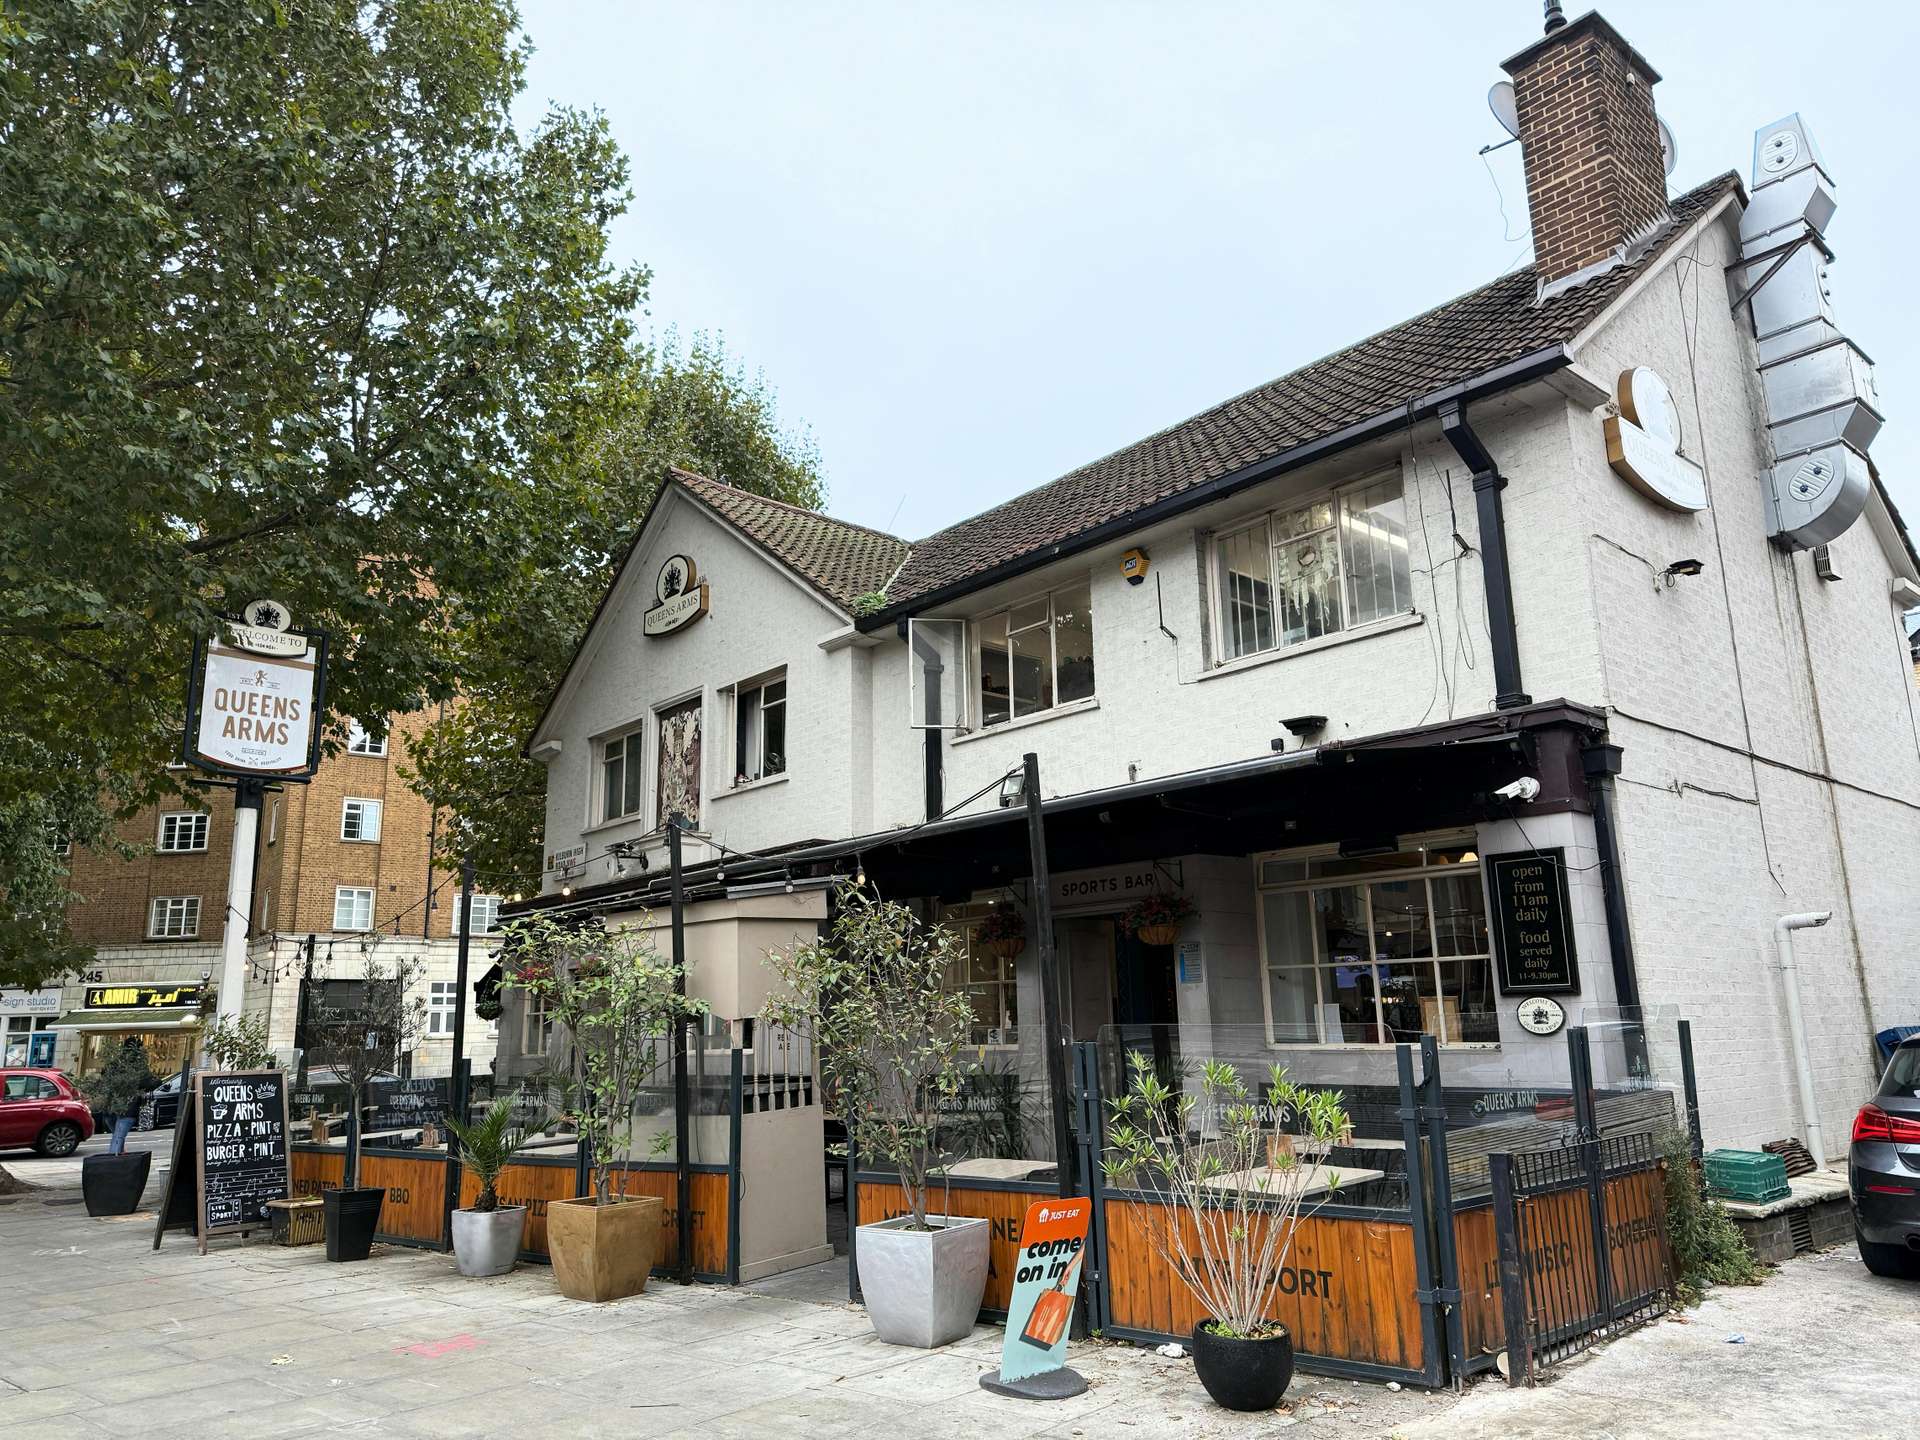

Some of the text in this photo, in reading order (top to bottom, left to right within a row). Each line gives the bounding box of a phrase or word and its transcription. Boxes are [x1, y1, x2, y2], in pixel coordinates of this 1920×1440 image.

[647, 605, 676, 627] QUEENS
[676, 595, 698, 613] ARMS
[288, 637, 303, 648] TO
[214, 687, 301, 722] QUEENS
[222, 715, 289, 746] ARMS
[1512, 866, 1542, 880] open
[1062, 873, 1154, 897] SPORTS BAR
[1514, 881, 1544, 893] from
[1513, 895, 1549, 907] 11am
[1516, 907, 1548, 923] daily
[1520, 930, 1550, 944] food
[1520, 945, 1552, 957] served
[1525, 957, 1550, 970] daily
[79, 971, 102, 983] 245
[27, 995, 57, 1006] studio
[104, 989, 138, 1005] AMIR
[213, 1085, 254, 1103] QUEENS
[526, 1096, 544, 1107] ARMS
[1484, 1090, 1539, 1112] QUEENS ARMS
[233, 1102, 264, 1121] ARMS
[967, 1096, 997, 1112] ARMS
[207, 1121, 272, 1139] PIZZA PINT
[206, 1144, 246, 1161] BURGER
[254, 1141, 275, 1157] PINT
[389, 1187, 409, 1205] BBQ
[662, 1209, 706, 1231] CRFT
[1049, 1208, 1081, 1221] JUST EAT
[1027, 1236, 1082, 1259] come
[1017, 1264, 1043, 1284] on
[1047, 1256, 1069, 1280] in
